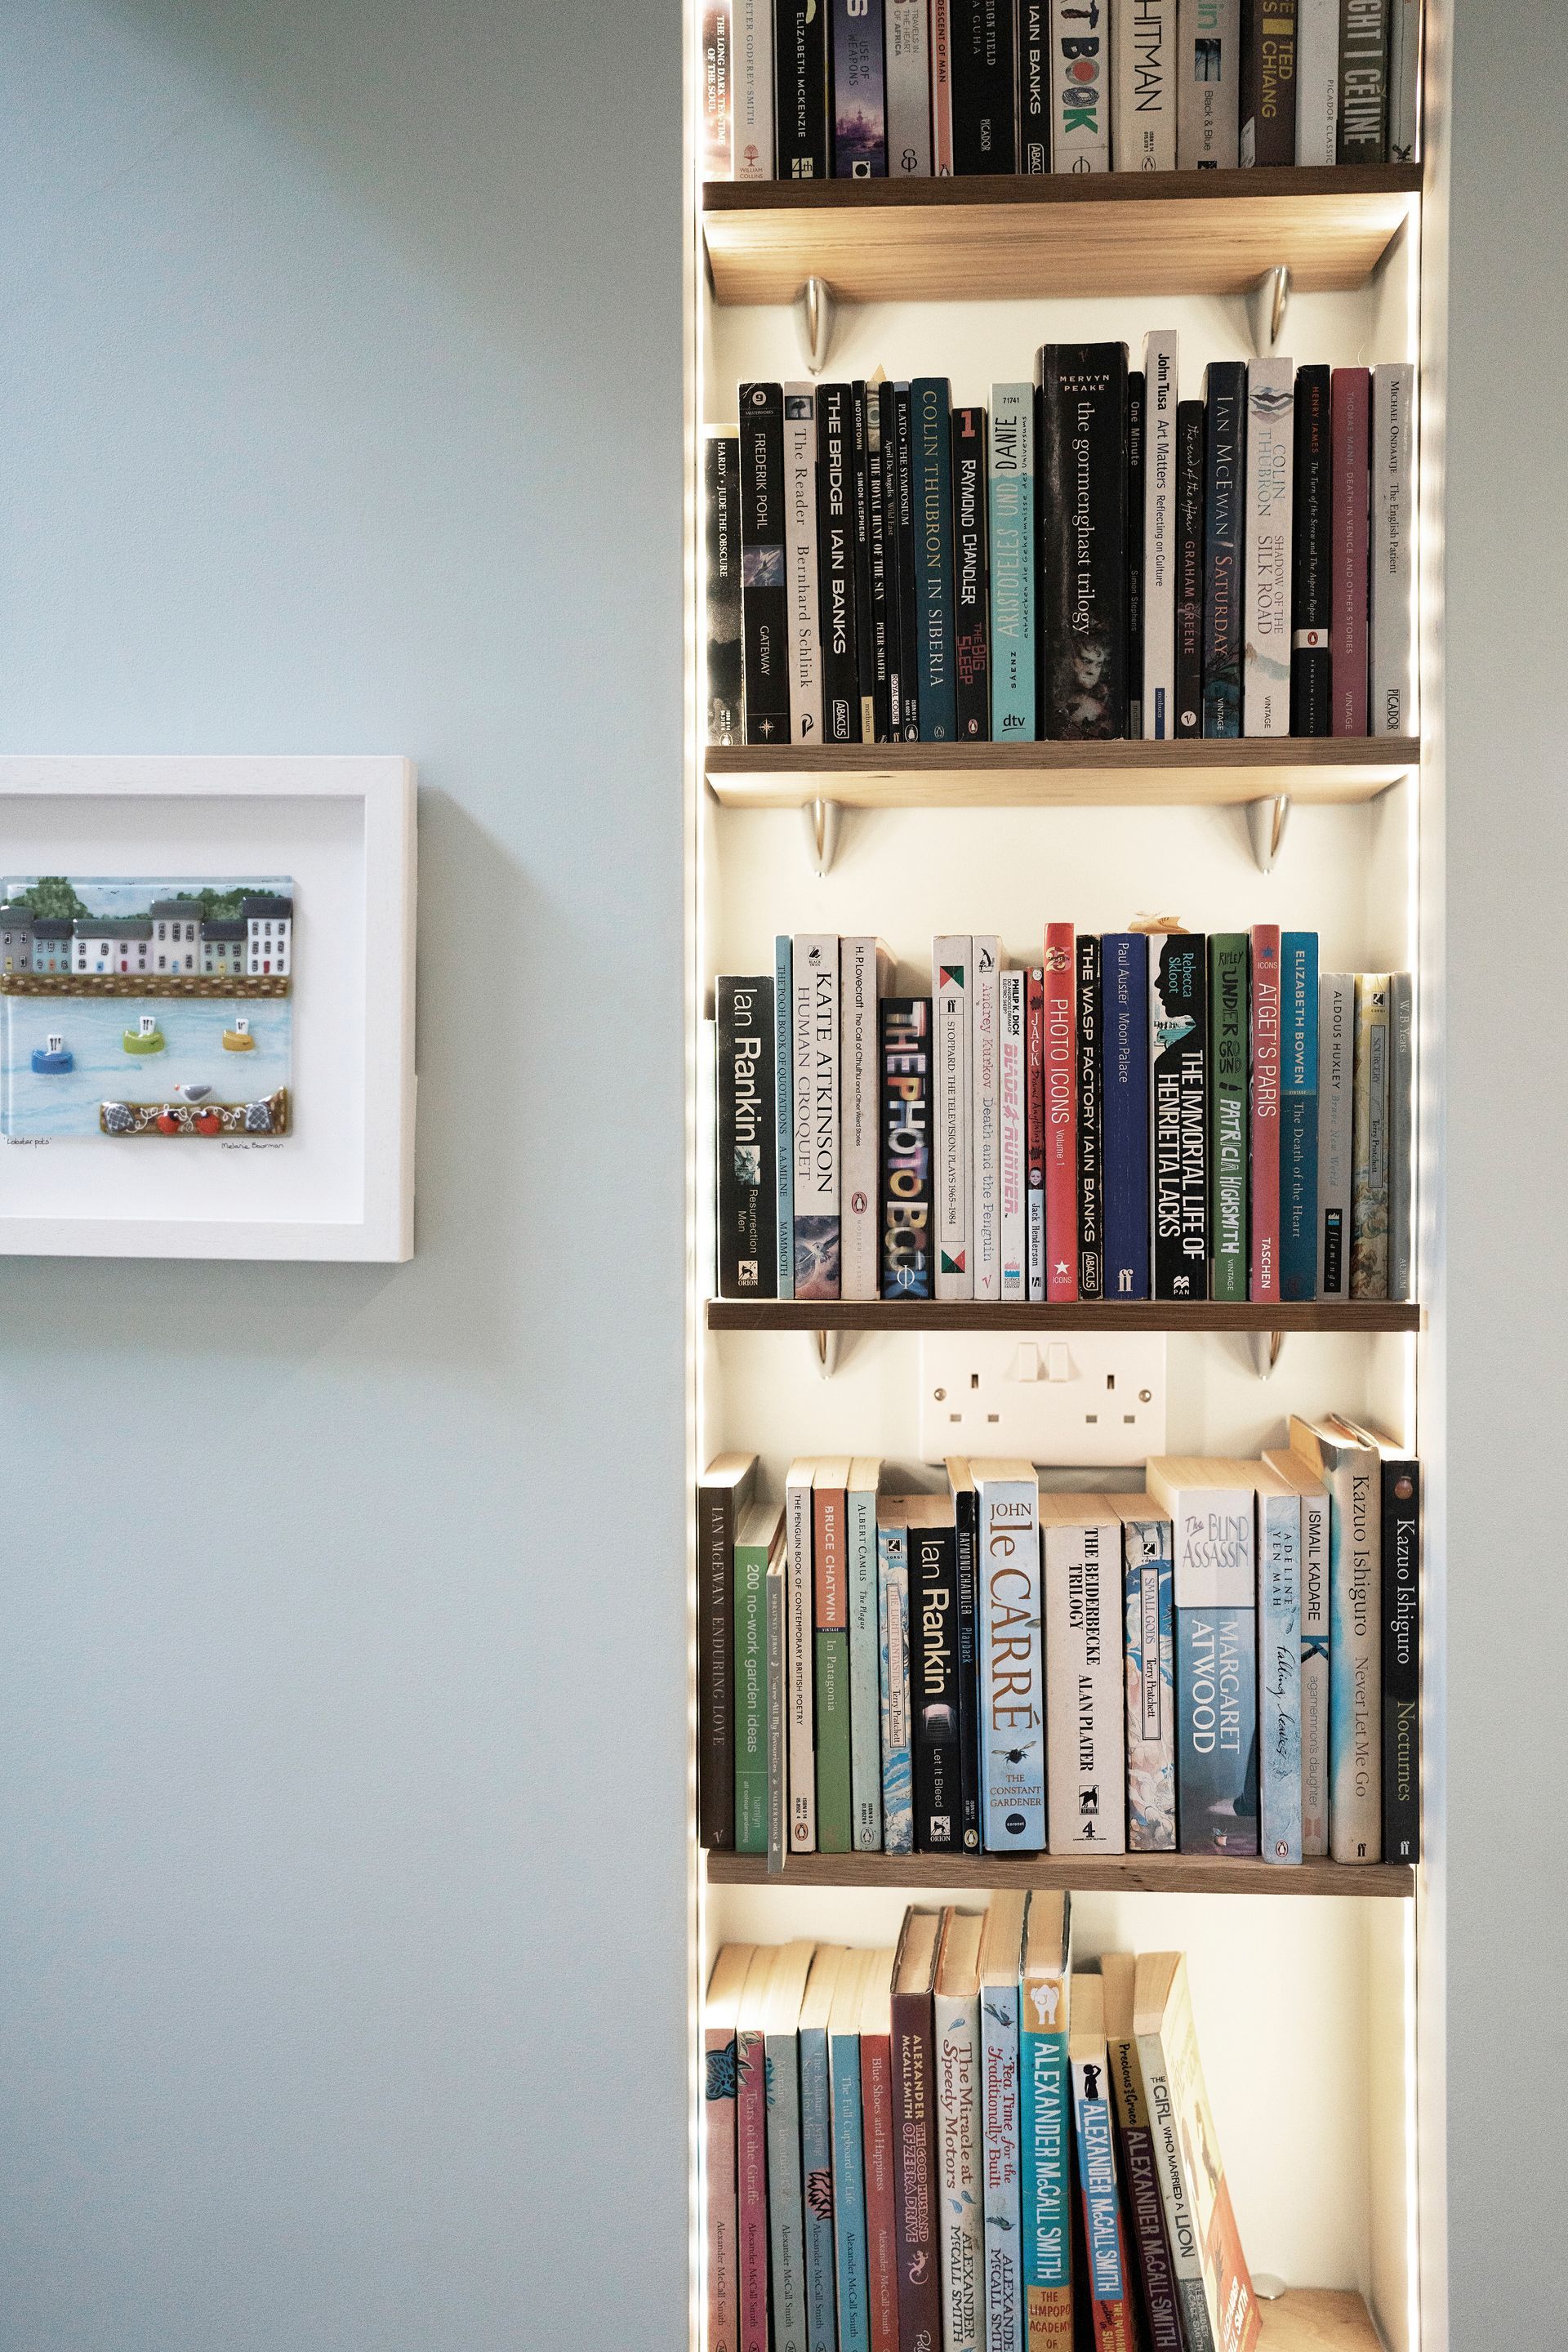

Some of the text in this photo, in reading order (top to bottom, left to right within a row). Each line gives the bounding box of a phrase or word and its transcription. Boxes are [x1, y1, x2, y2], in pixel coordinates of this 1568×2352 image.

[707, 48, 716, 113] OF THE SOUL
[716, 16, 727, 145] THE LONG DARK TEA-TIME
[796, 12, 806, 138] ELIZABETH MCKENZIE
[938, 0, 947, 82] DESCENT OF MAN
[1029, 6, 1041, 115] IAIN BANKS
[1261, 41, 1276, 118] CHIANG
[1279, 41, 1293, 80] TED
[1325, 79, 1334, 121] PICADOR
[980, 119, 991, 152] PICADOR
[1203, 90, 1214, 118] Black
[1203, 129, 1214, 151] Blue
[1343, 69, 1384, 145] CÉLINE
[1059, 374, 1111, 382] MERVYN
[1063, 384, 1106, 392] PEAKE
[828, 392, 846, 654] THE BRIDGE IAIN BANKS
[1071, 401, 1096, 636] the gormenghast trilogy
[1155, 354, 1170, 587] John Tusa Art Matters Reflecting on Culture
[1388, 381, 1401, 574] MICHAEL ONDAATJE The English Patient
[795, 428, 813, 688] The Reader Bernhard Schlink
[921, 390, 945, 688] COLIN THUBRON IN SIBERIA
[960, 459, 978, 605] RAYMOND CHANDLER
[1012, 978, 1020, 1036] PHILIP K. DICK
[1117, 942, 1131, 1084] Paul Auster Moon Palace
[1168, 956, 1181, 995] Skloot
[1182, 952, 1196, 998] Rebecca
[1294, 950, 1306, 1085] ELIZABETH BOWEN
[733, 988, 763, 1142] Ian Rankin
[795, 986, 811, 1182] HUMAN CROQUET
[817, 971, 833, 1194] KATE ATKINSON
[884, 1001, 927, 1074] THE
[1049, 998, 1071, 1124] PHOTO ICONS
[1082, 943, 1096, 1242] THE WASP FACTORY IAIN BANKS
[1258, 1065, 1277, 1117] PARIS
[1331, 990, 1343, 1089] ALDOUS HUXLEY
[1157, 1073, 1181, 1238] HENRIETTA LACKS
[1181, 1049, 1205, 1260] THE IMMORTAL LIFE OF
[1219, 1098, 1243, 1254] PATRICIA HIGHSMITH
[738, 1209, 747, 1232] Men
[749, 1188, 760, 1254] Resurrection
[1085, 1254, 1097, 1289] ABACUS
[1227, 1258, 1235, 1291] VINTAGE
[1261, 1237, 1272, 1289] TASCHEN
[991, 1503, 1032, 1520] JOHN
[1308, 1510, 1321, 1621] ISMAIL KADARE
[921, 1540, 952, 1694] Ian Rankin
[989, 1521, 1040, 1731] le CARRÉ
[1069, 1563, 1084, 1630] TRILOGY
[1085, 1528, 1101, 1666] THE BEIDERBECKE
[1348, 1475, 1371, 1797] Kazuo Ishiguro Never Let Me Go
[744, 1564, 760, 1753] 200 no-work garden ideas
[1192, 1619, 1216, 1753] ATWOOD
[1219, 1621, 1240, 1754] MARGARET
[1390, 1519, 1417, 1802] Kazuo Ishiguro Nocturnes
[933, 1748, 944, 1807] Let It Bleed
[1079, 1674, 1094, 1771] ALAN PLATER
[940, 2039, 959, 2189] Speedy Motors
[958, 2042, 974, 2185] The Miracle at
[1033, 2042, 1062, 2158] ALEXANDER
[1152, 2085, 1196, 2258] GIRL WHO MARRIED A LION
[1036, 2227, 1062, 2279] SMITH
